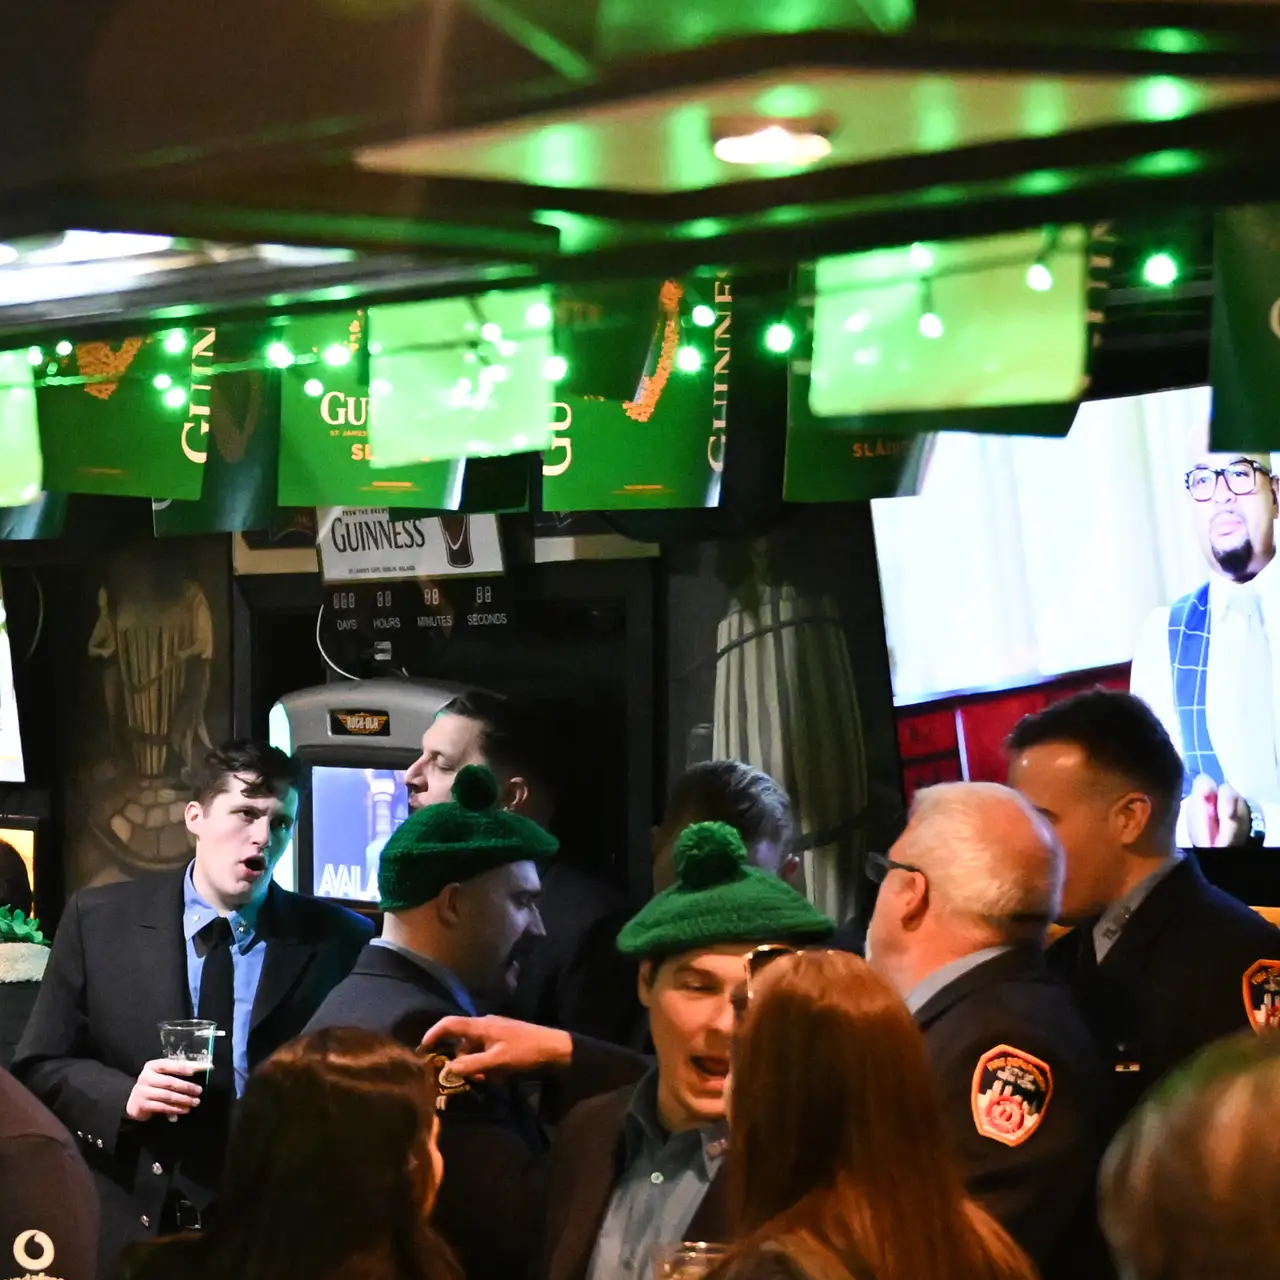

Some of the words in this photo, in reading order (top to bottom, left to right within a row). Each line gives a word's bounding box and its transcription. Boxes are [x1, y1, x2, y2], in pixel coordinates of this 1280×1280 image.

[708, 272, 732, 473] GUINNE
[331, 517, 426, 553] GUINNESS
[337, 619, 358, 630] DAYS
[373, 616, 402, 629] HOURS
[417, 614, 453, 628] MINUTES
[466, 612, 508, 626] SECONDS
[318, 863, 382, 902] AVAILA
